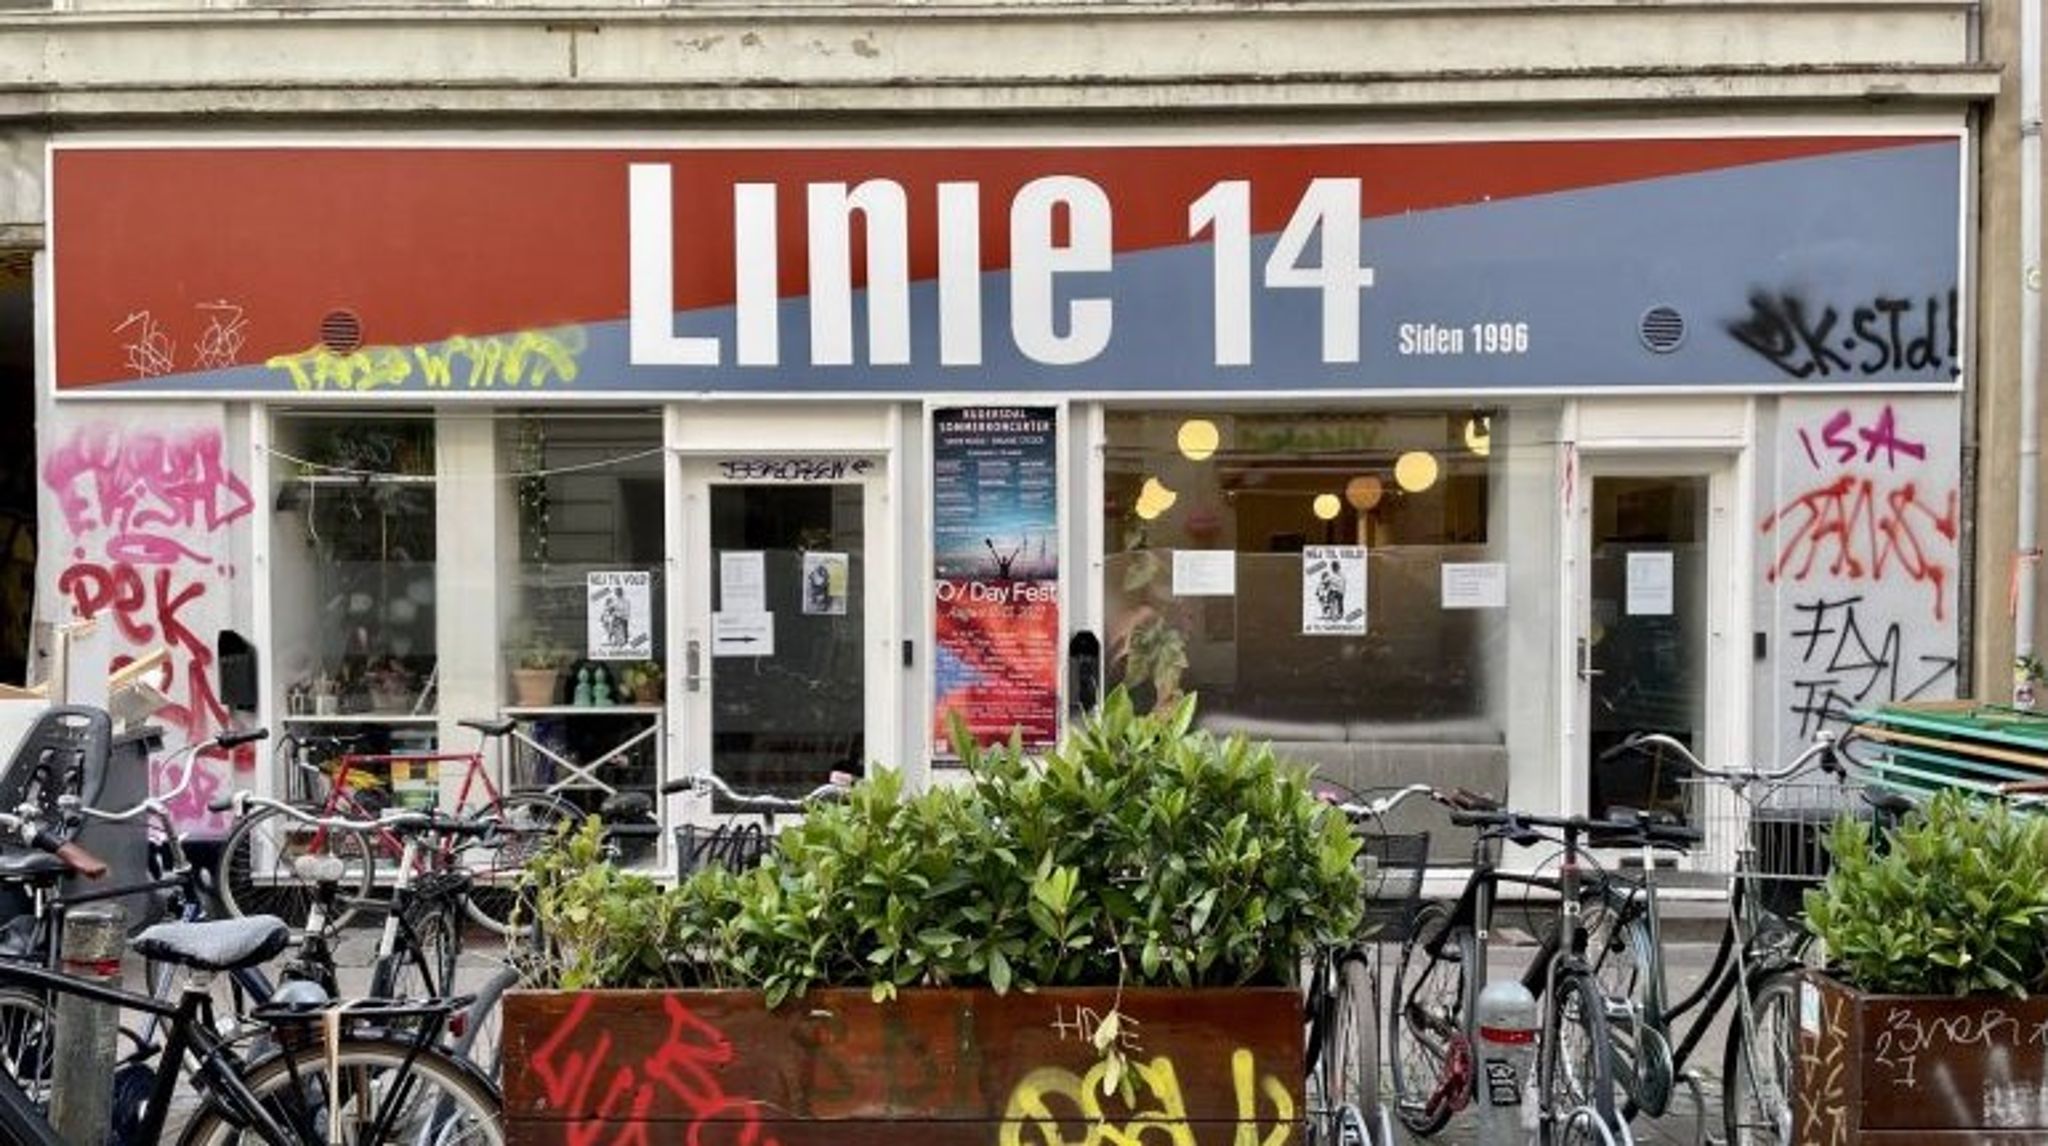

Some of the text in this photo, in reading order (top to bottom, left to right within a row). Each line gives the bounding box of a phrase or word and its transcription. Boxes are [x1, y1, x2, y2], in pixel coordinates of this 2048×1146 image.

[628, 163, 1374, 366] Linie 14
[1399, 322, 1529, 355] Siden 1996
[970, 582, 1009, 604] Day
[1013, 581, 1058, 601] Fest
